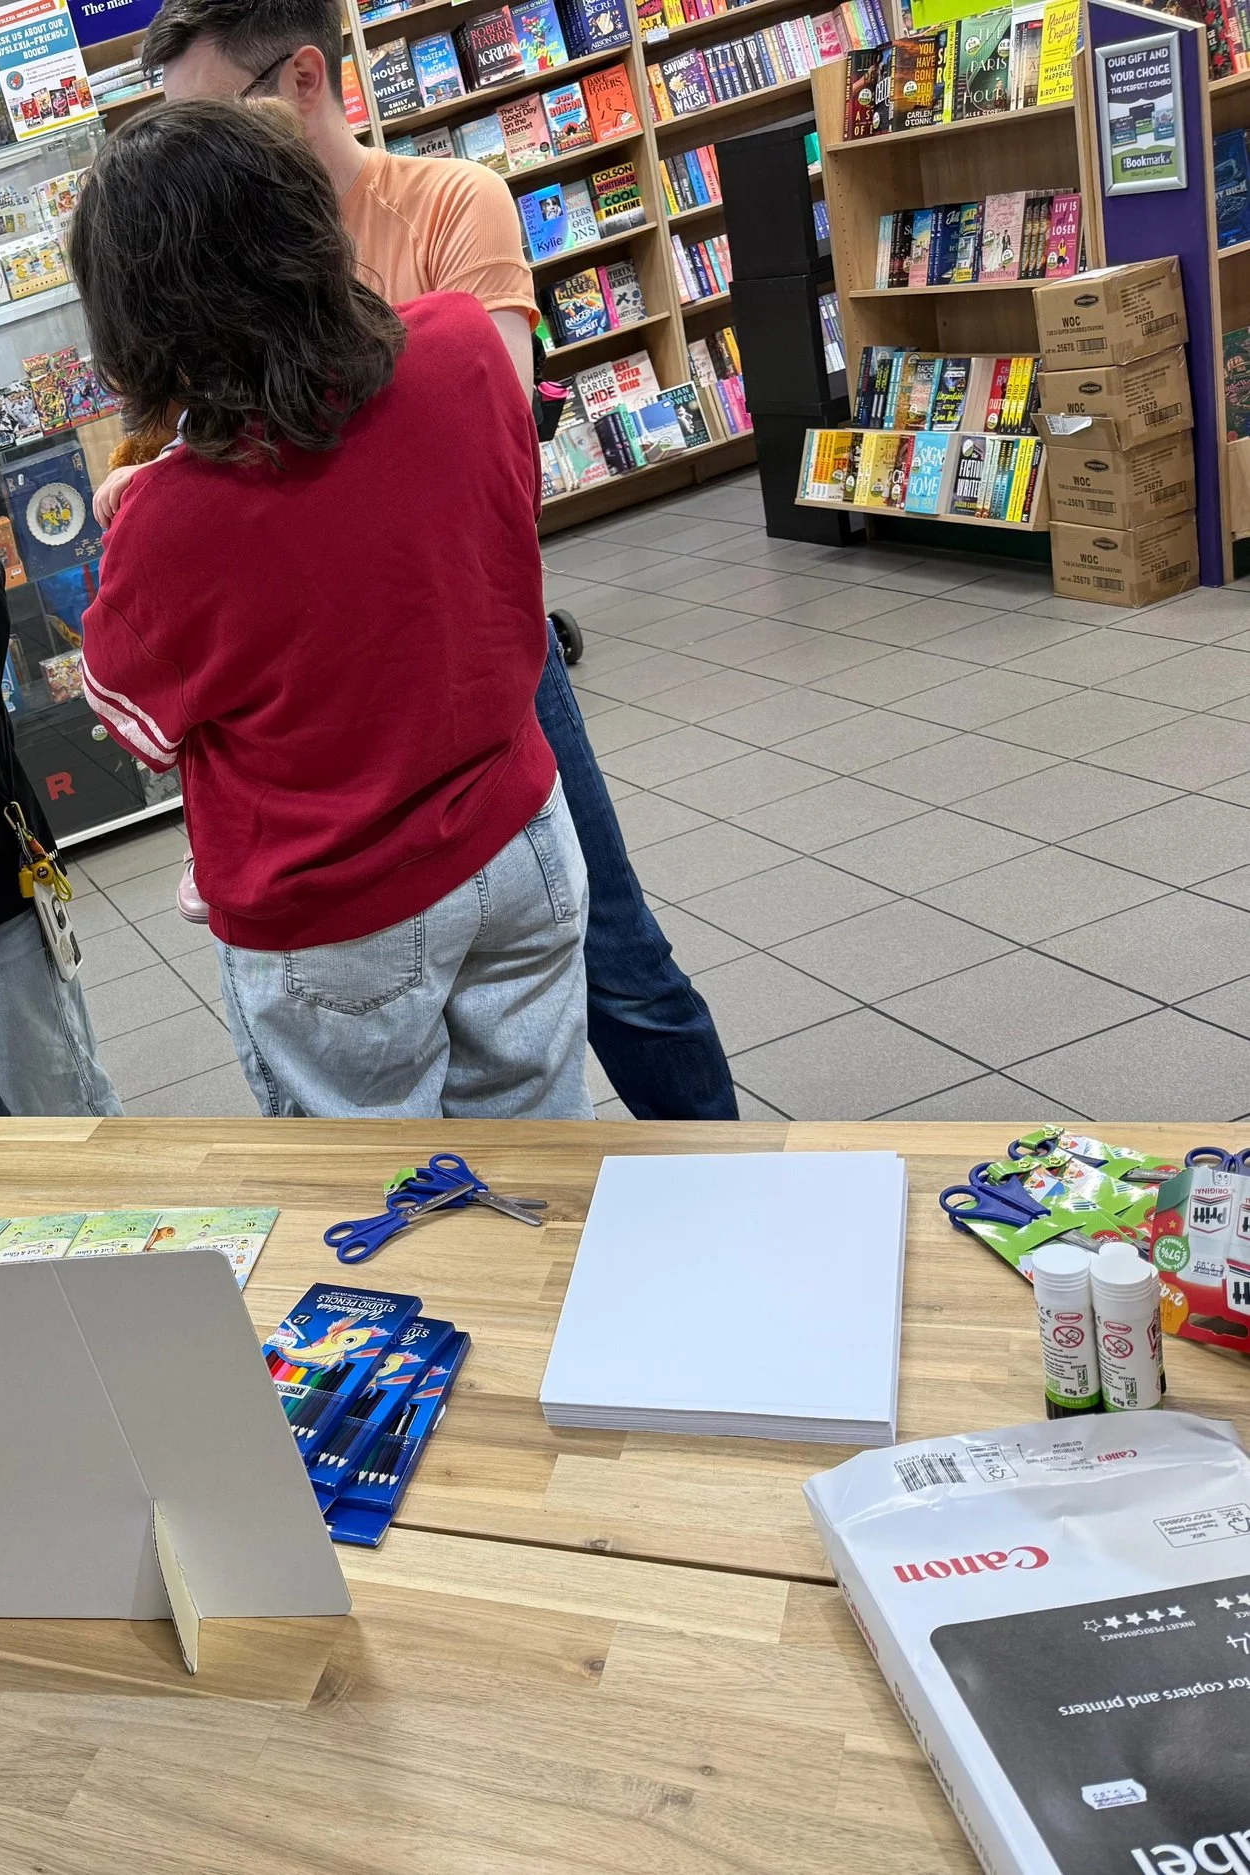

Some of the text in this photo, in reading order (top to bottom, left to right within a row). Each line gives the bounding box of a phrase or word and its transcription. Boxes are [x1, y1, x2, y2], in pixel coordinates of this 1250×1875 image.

[82, 2, 106, 17] The
[12, 30, 23, 41] US
[24, 24, 48, 38] ABOUT
[49, 18, 63, 29] OUR
[469, 18, 512, 39] ROBERT
[1048, 22, 1077, 45] English
[471, 28, 516, 50] HARRIS
[23, 45, 49, 60] BOOKS!
[421, 49, 448, 63] SISTERS
[918, 43, 935, 55] YOU
[916, 56, 936, 68] HAVE
[970, 57, 1007, 73] PARIS
[1107, 48, 1169, 68] OUR GIFT AND
[371, 62, 409, 81] HOUSE
[427, 62, 447, 73] HOPE
[914, 69, 935, 80] GONE
[1110, 63, 1170, 84] YOUR CHOICE
[373, 78, 415, 98] WINTER
[587, 76, 607, 88] DAVE
[588, 79, 624, 95] EGGERS
[917, 82, 931, 94] TOO
[1111, 78, 1172, 95] THE PERFECT COMBO
[554, 92, 573, 105] JON
[675, 84, 699, 100] CHLOE
[1040, 84, 1074, 98] BIRDY TROY
[388, 99, 408, 111] EMILY
[674, 91, 707, 114] WALSH
[916, 95, 931, 106] FAR
[500, 100, 530, 117] The Last
[502, 105, 537, 123] Good Day
[503, 116, 527, 129] on the
[505, 122, 533, 136] Internet
[417, 139, 447, 156] JACKAL
[594, 165, 633, 183] COLSON
[595, 175, 635, 194] WHITEHEAD
[604, 189, 637, 206] COOL
[604, 199, 641, 217] MACHINE
[1055, 201, 1077, 212] LIV IS
[572, 216, 593, 228] OUR
[1052, 224, 1076, 236] LOSER
[536, 237, 563, 253] Kylie
[558, 280, 595, 300] MILLER
[565, 276, 586, 289] BEN
[1062, 316, 1081, 327] WOC
[1134, 311, 1154, 325] 25678
[575, 319, 599, 338] PURSUIT
[1057, 343, 1075, 352] 25678
[613, 361, 630, 373] BEST
[581, 369, 608, 384] CHRIS
[616, 368, 641, 382] OFFER
[580, 377, 615, 394] CARTER
[619, 379, 640, 393] WINS
[585, 386, 617, 406] HIDE
[661, 387, 690, 400] BRIAN
[1067, 403, 1085, 413] WOC
[1138, 401, 1158, 414] 25678
[910, 475, 938, 496] HOME
[1073, 476, 1091, 487] WOC
[1080, 553, 1099, 565] WOC
[1193, 1207, 1227, 1225] Pritt
[1161, 1246, 1182, 1262] 97%
[317, 1295, 357, 1308] PENCILS
[358, 1302, 397, 1313] STUDIO
[294, 1315, 311, 1325] 12
[1057, 1313, 1081, 1322] Henkel
[1064, 1387, 1078, 1396] 43g
[1096, 1449, 1138, 1463] Canon
[892, 1546, 1050, 1584] Canon
[842, 1582, 880, 1660] Canon
[1099, 1620, 1196, 1643] INKJET PERFORMANCE
[1058, 1676, 1250, 1717] for copiers and printers
[923, 1736, 955, 1802] Label
